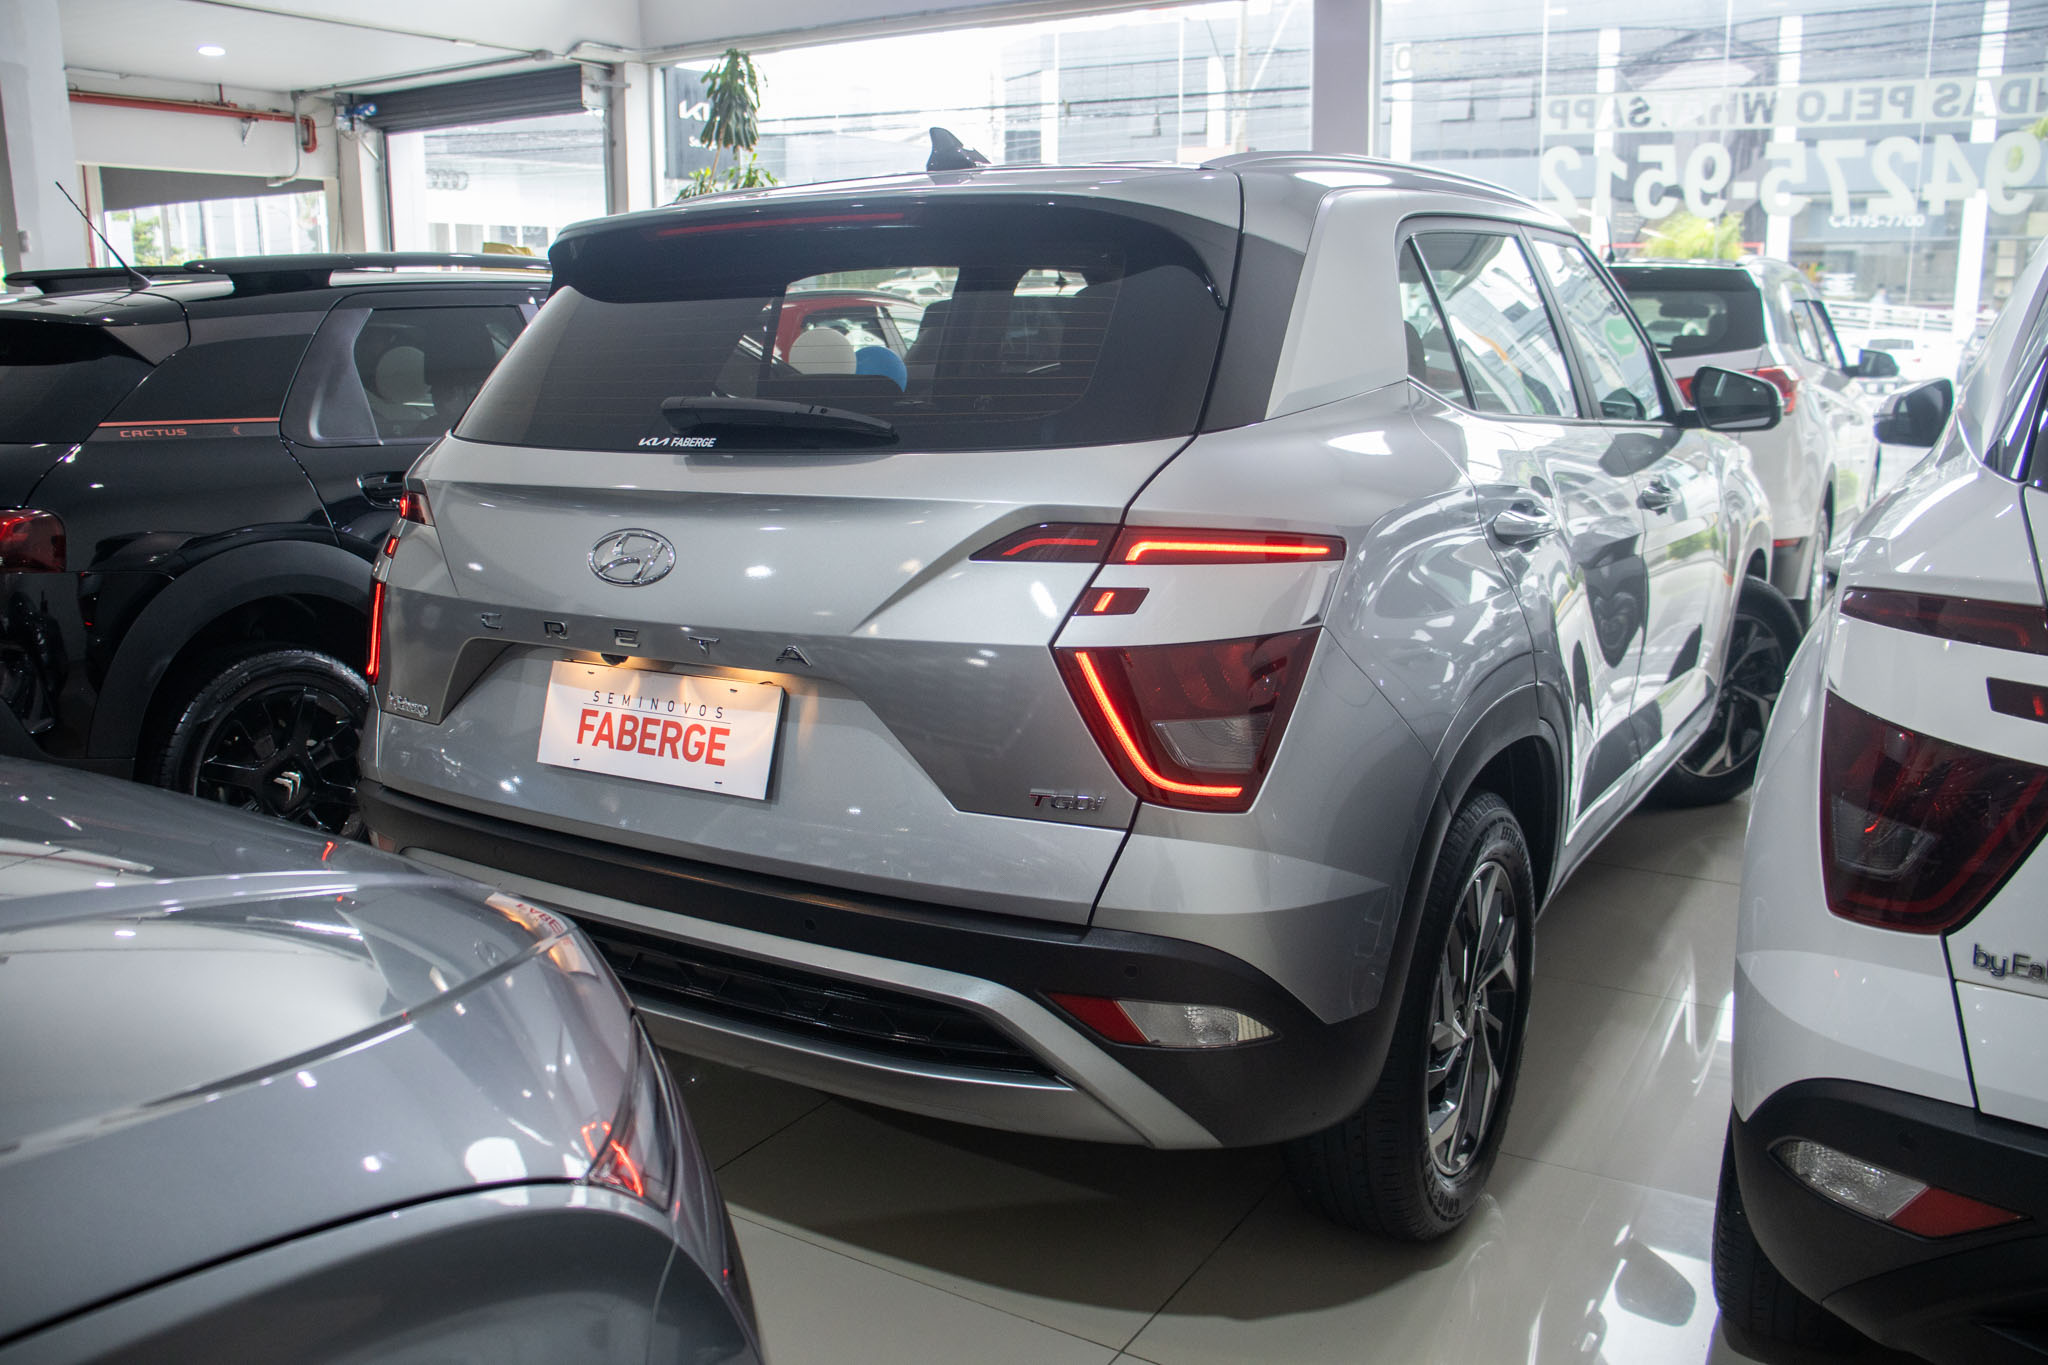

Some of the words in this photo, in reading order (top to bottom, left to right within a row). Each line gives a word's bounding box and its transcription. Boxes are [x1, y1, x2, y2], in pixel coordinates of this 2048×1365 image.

[119, 428, 187, 438] CACTUS
[638, 437, 670, 447] KIA
[670, 437, 717, 448] FABERGE
[480, 612, 812, 667] CRETA
[592, 690, 724, 718] SEMINOVOS
[576, 708, 731, 766] FABERGE
